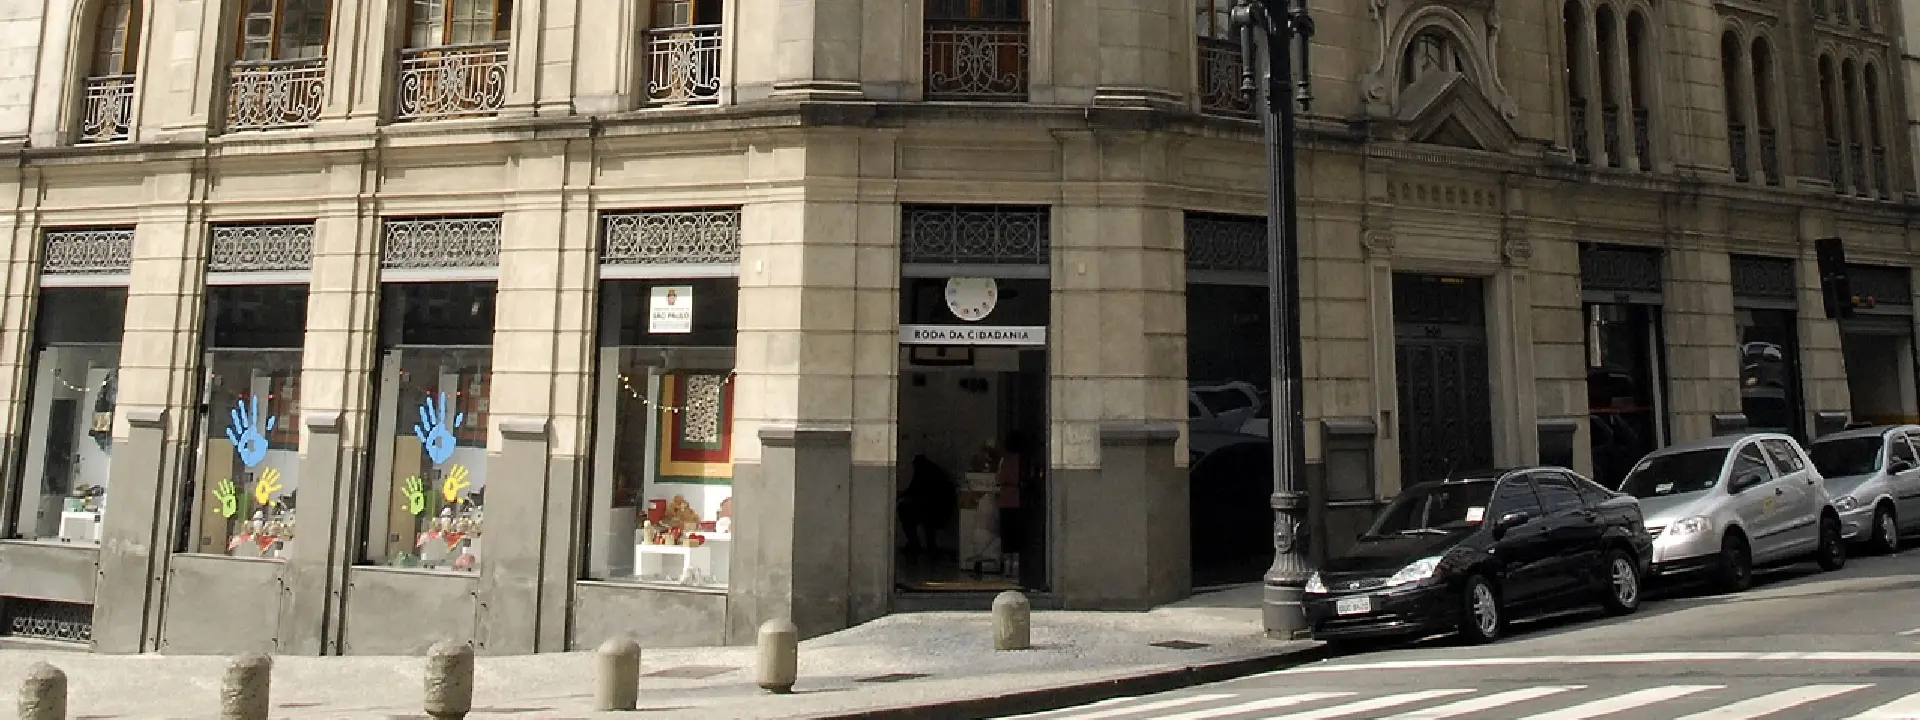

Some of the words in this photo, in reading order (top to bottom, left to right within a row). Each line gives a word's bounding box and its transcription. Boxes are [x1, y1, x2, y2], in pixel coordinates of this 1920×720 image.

[914, 329, 946, 339] RODA
[949, 329, 965, 339] DA
[967, 329, 1029, 340] CIDADANIA
